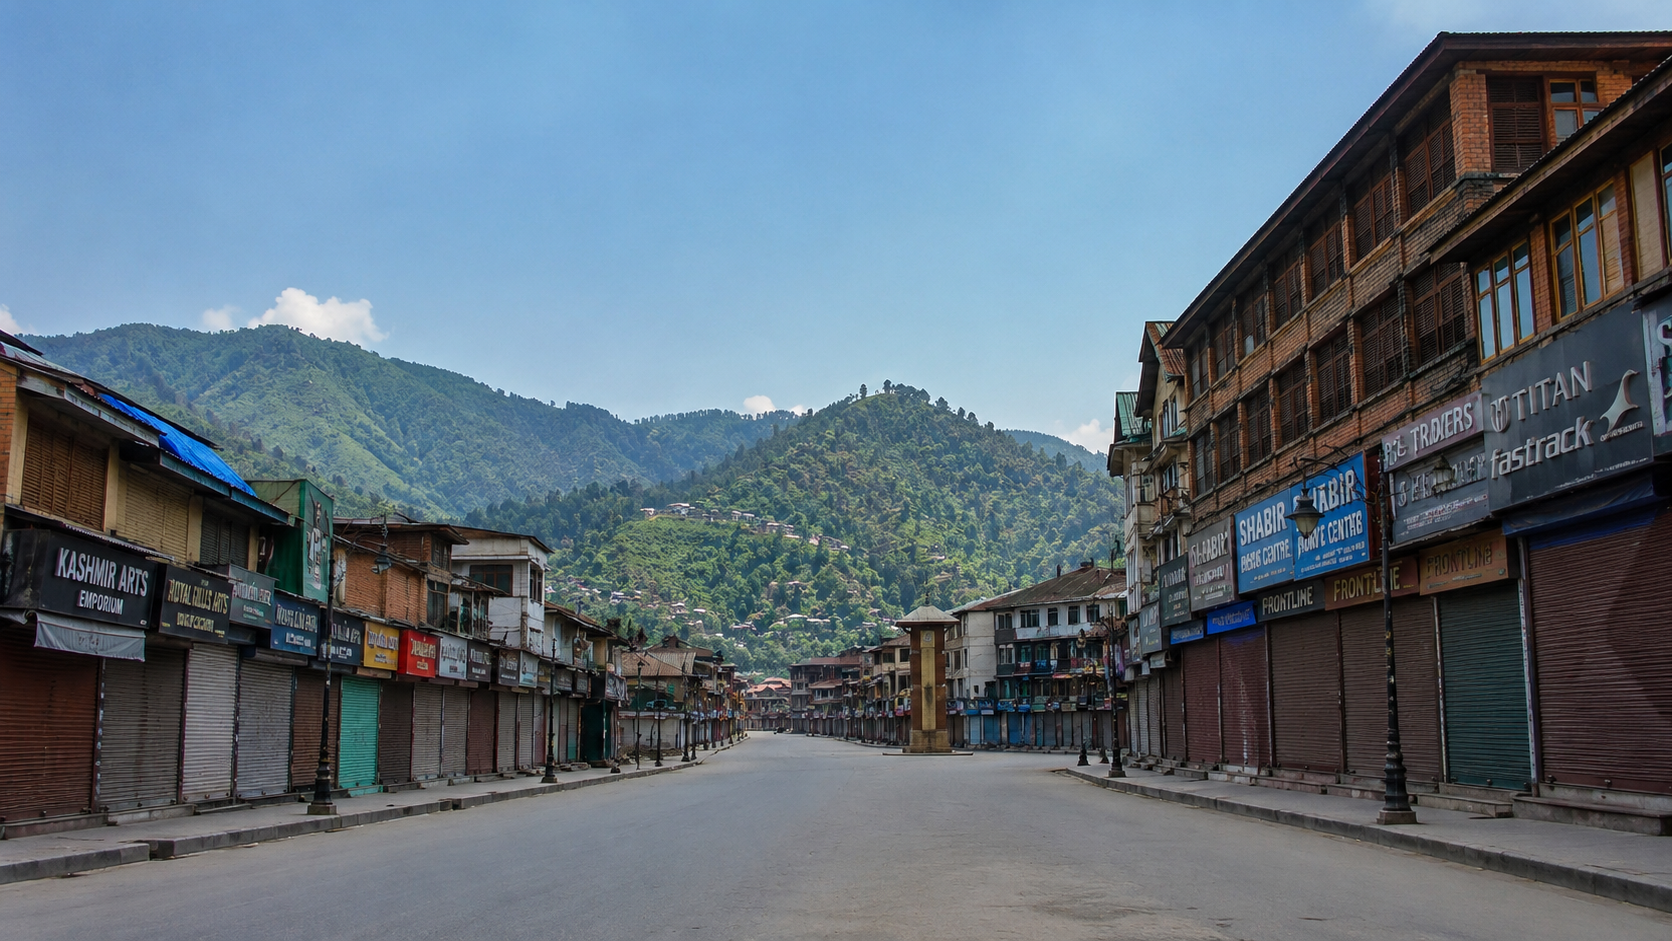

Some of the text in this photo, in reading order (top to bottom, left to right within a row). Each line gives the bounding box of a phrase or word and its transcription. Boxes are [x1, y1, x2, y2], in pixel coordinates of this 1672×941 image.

[1511, 361, 1593, 421] TITAN
[1490, 416, 1596, 480] fastrack
[1239, 501, 1288, 547] SHABIR
[55, 547, 149, 598] KASHMIR ARTS
[78, 589, 124, 615] EMPORIUM
[1262, 586, 1314, 616] FRONTLINE
